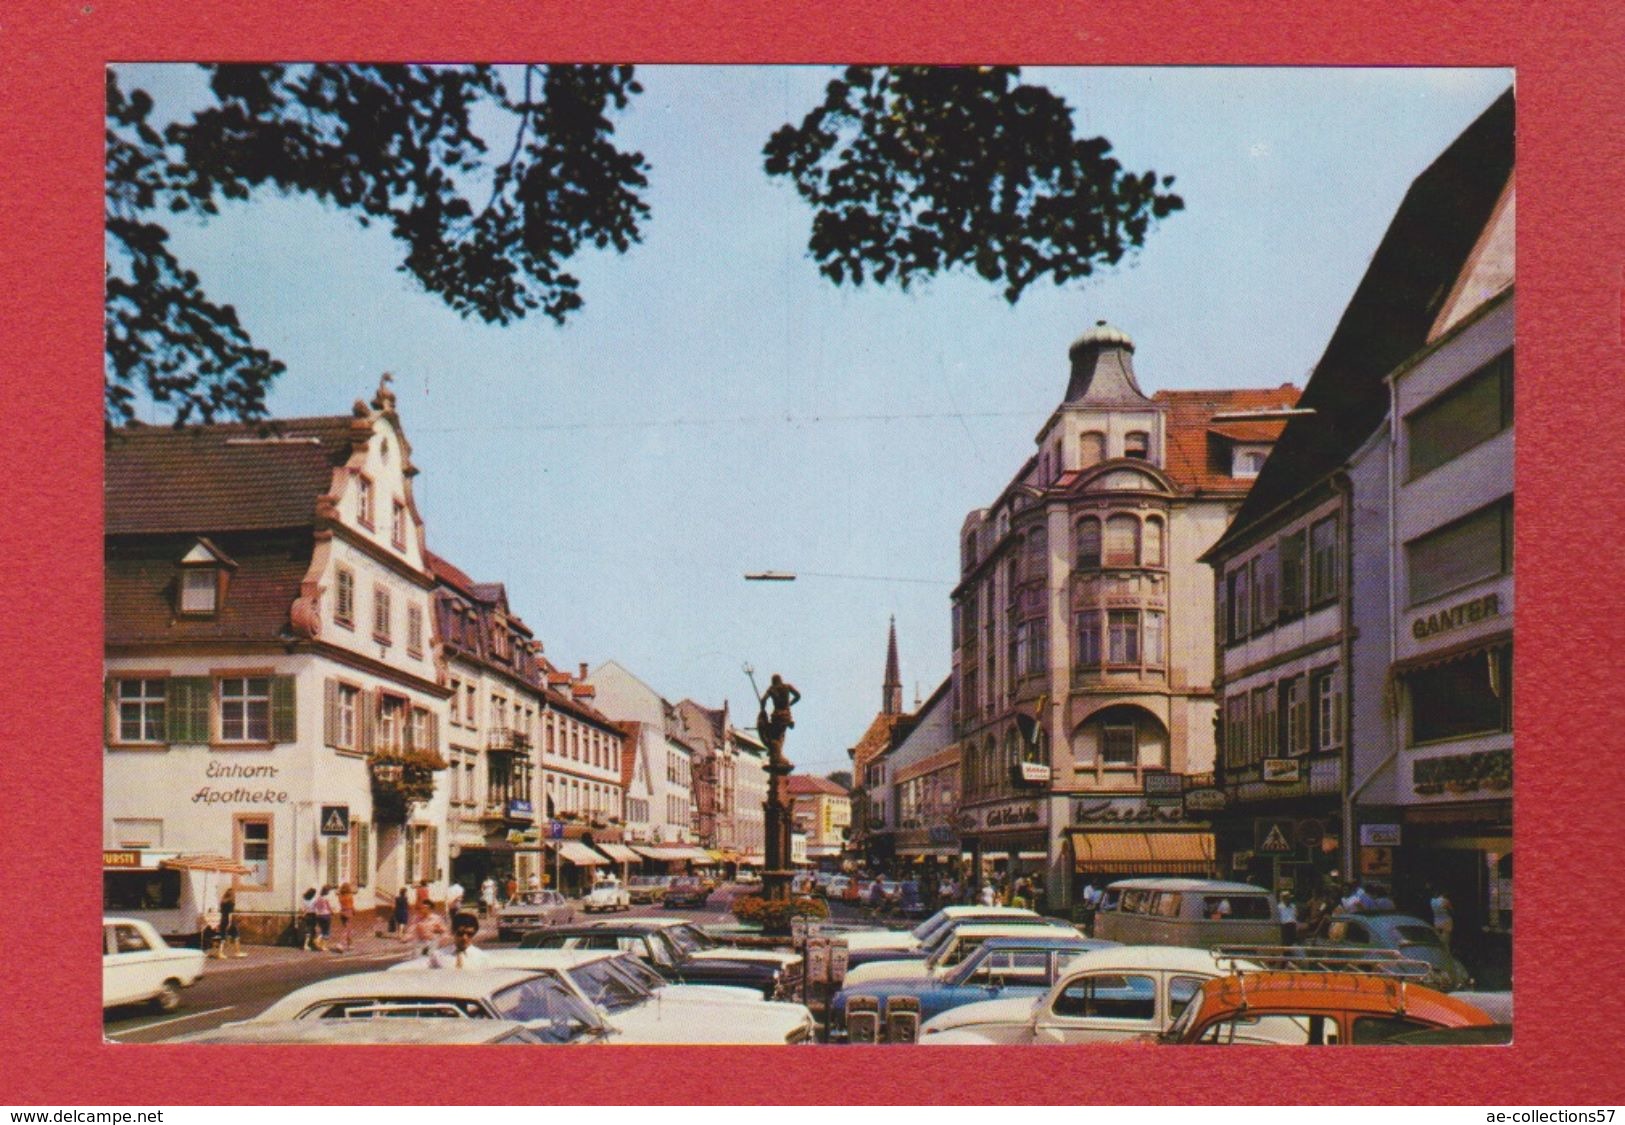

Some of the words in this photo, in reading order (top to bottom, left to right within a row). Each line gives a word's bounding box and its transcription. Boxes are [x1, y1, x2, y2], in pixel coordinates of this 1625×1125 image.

[1412, 592, 1499, 640] GANTER
[206, 760, 279, 778] Einhorn-
[191, 786, 288, 806] Apotheke
